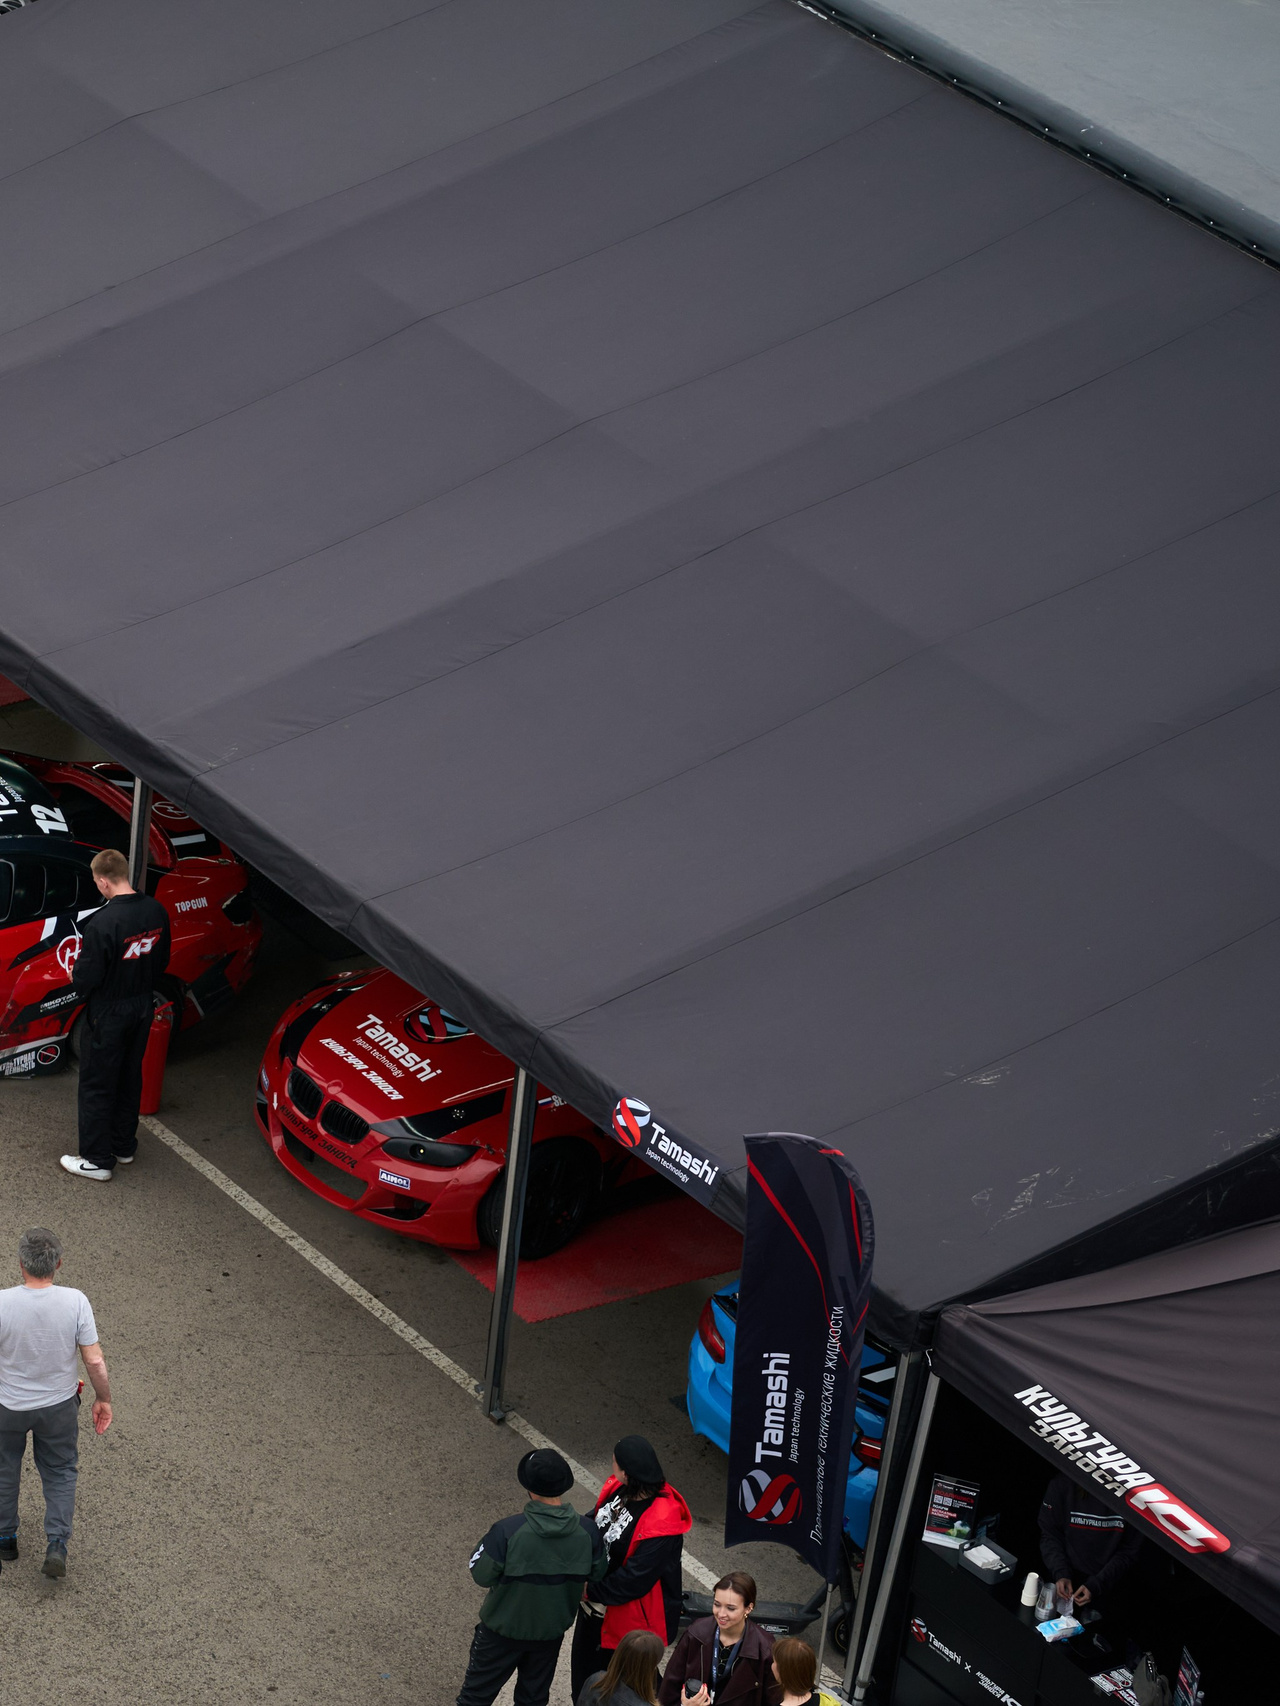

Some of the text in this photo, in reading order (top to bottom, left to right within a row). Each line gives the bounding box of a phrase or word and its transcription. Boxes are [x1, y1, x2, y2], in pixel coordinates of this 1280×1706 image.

[30, 803, 69, 834] 12
[319, 1037, 404, 1100] КУЛЬТУРА ЗАНОСА
[356, 1013, 442, 1083] Tamashi
[370, 1048, 405, 1078] technology
[279, 1104, 358, 1169] КУЛЬТУРА ЗАНОСА
[650, 1122, 719, 1185] Tamashi
[380, 1172, 409, 1188] AIMOL
[660, 1158, 690, 1184] technology
[824, 1306, 844, 1370] жидкости
[755, 1352, 790, 1463] Tamashi
[791, 1387, 805, 1437] technology
[1014, 1384, 1155, 1489] КУЛЬТУРА
[1029, 1419, 1128, 1498] ЗАНОСА
[928, 1631, 962, 1665] Tamashi
